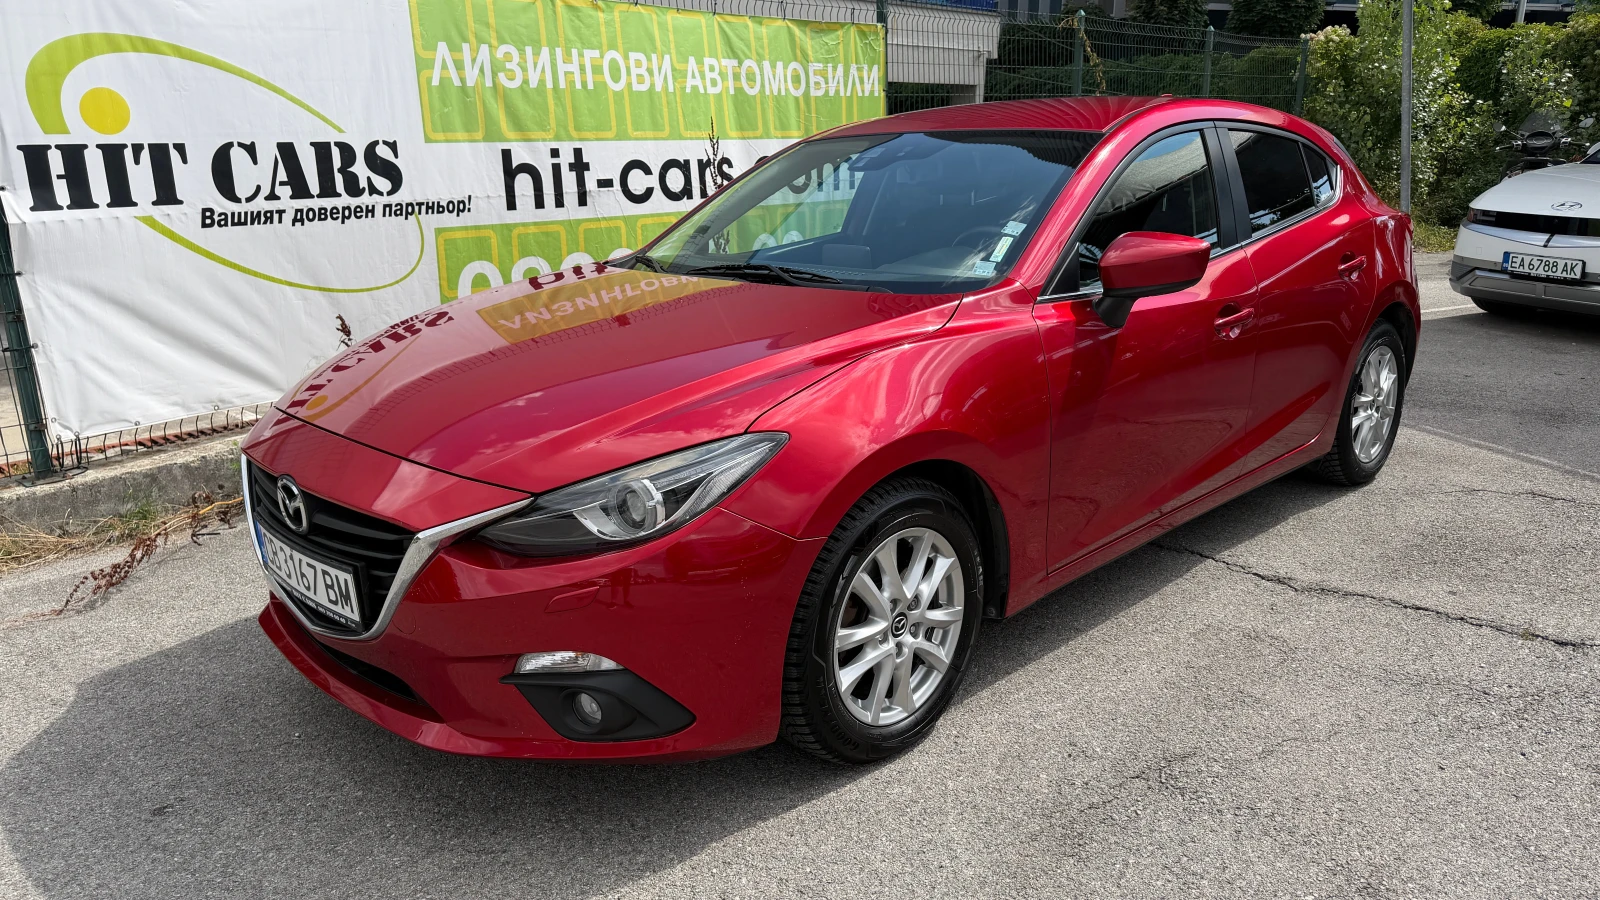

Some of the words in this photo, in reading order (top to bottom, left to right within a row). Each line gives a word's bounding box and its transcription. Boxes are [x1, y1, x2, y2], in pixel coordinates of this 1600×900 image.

[431, 41, 674, 93] ЛИЗИНГОВИ
[686, 56, 880, 97] АВТОМОБИЛИ
[16, 142, 189, 212] HIT
[211, 139, 404, 204] CARS
[200, 207, 286, 229] Вашият
[291, 203, 376, 227] доверен
[382, 195, 472, 221] партньор!
[1510, 255, 1525, 270] EA
[1528, 257, 1559, 274] 6788
[1561, 261, 1579, 277] AK
[279, 545, 318, 597] 3167
[321, 568, 355, 614] BM
